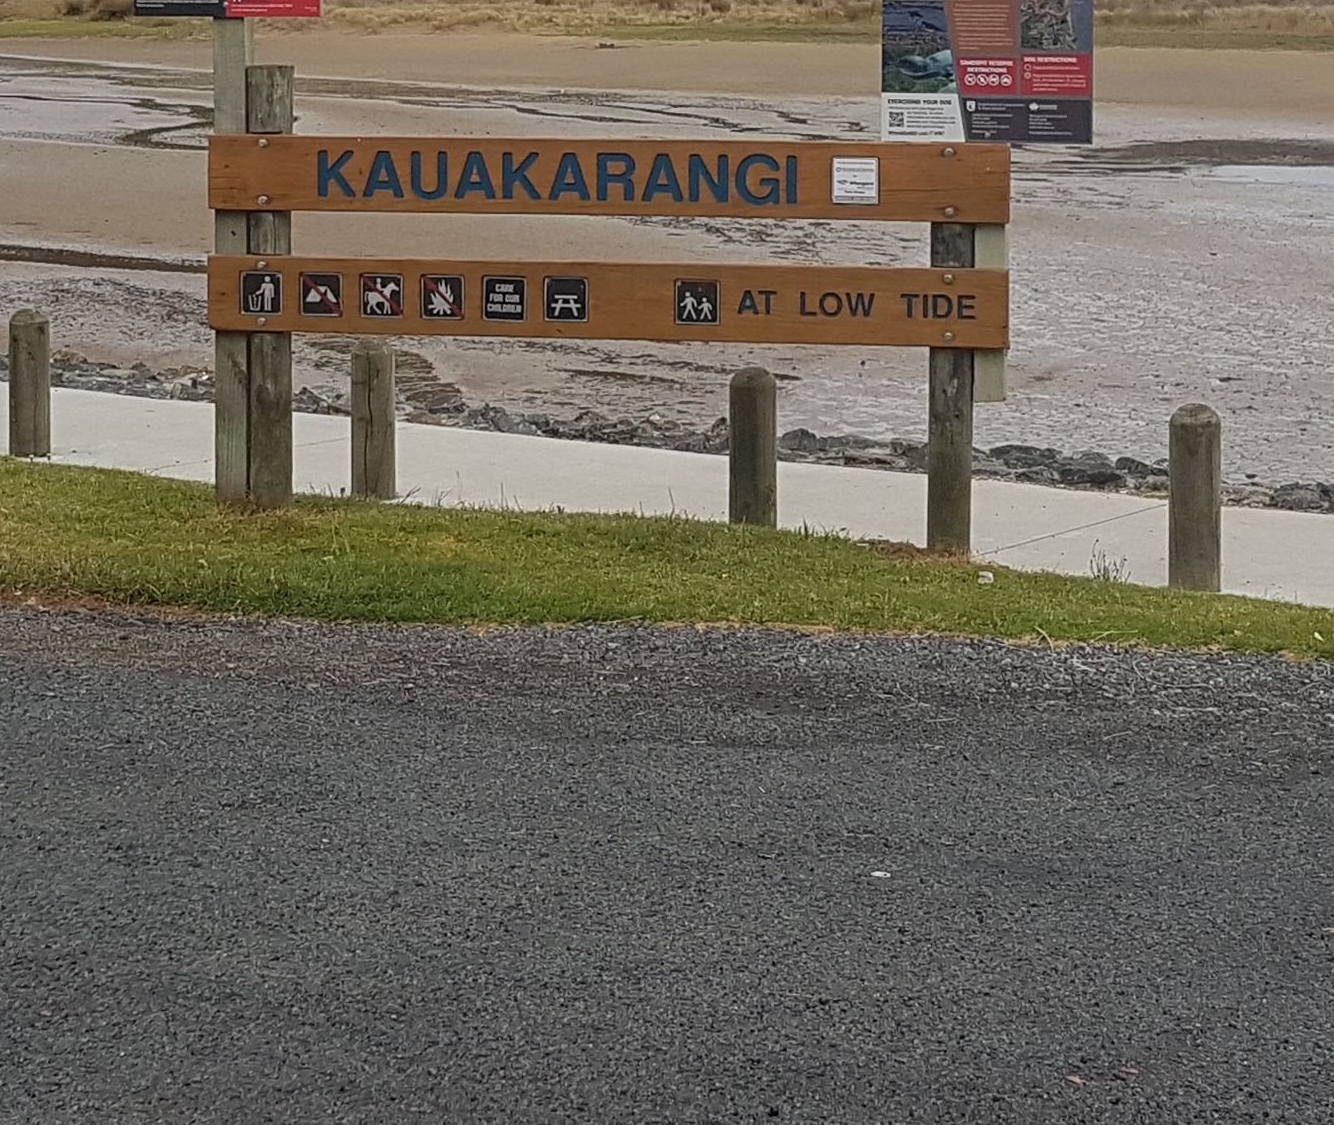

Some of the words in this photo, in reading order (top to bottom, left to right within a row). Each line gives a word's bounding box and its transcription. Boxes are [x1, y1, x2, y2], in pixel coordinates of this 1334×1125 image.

[316, 149, 799, 206] KAUAKARANGI
[737, 289, 777, 315] AT
[799, 291, 875, 317] LOW
[900, 293, 977, 320] TIDE
